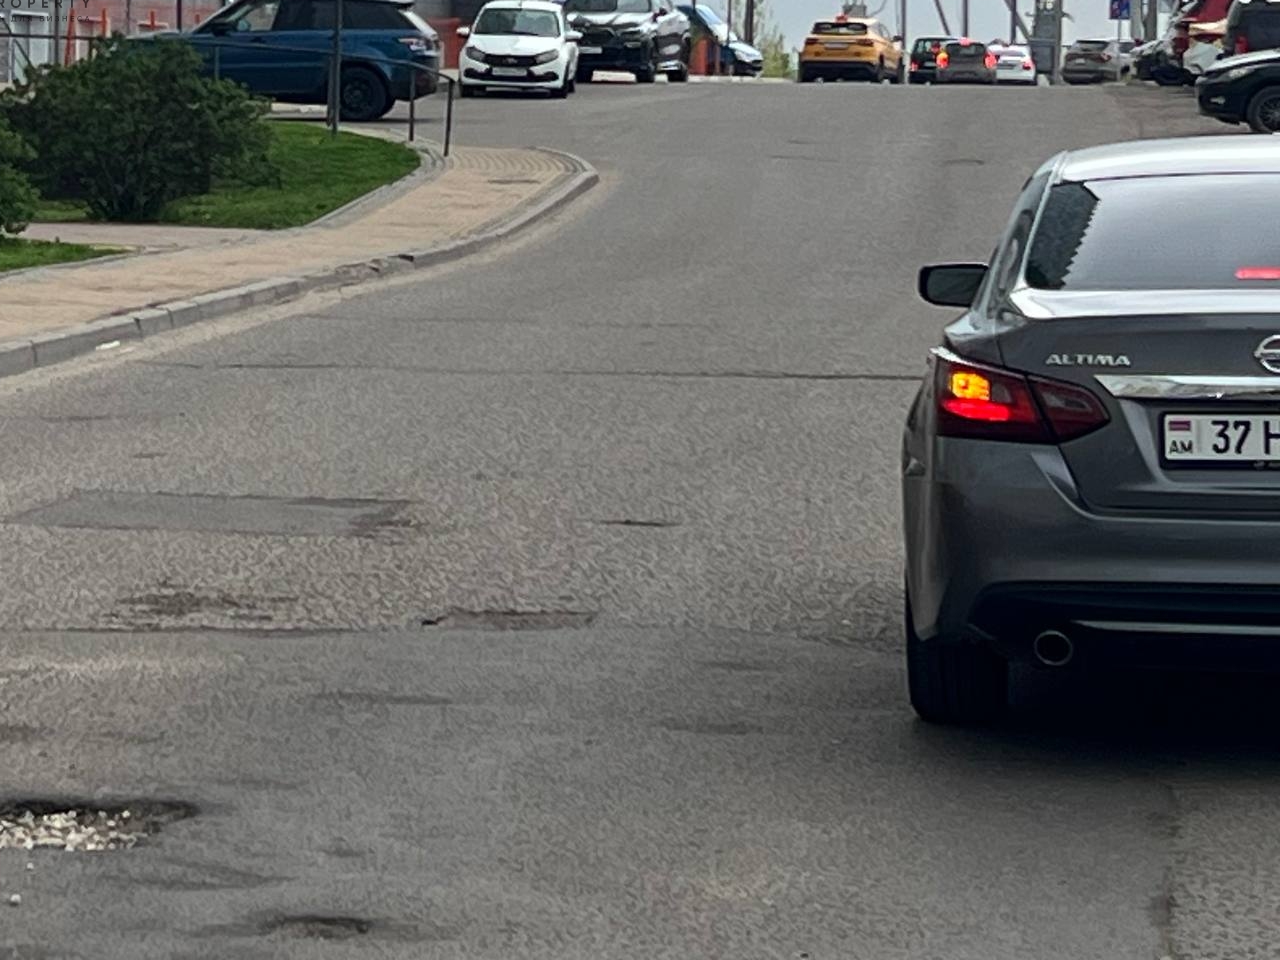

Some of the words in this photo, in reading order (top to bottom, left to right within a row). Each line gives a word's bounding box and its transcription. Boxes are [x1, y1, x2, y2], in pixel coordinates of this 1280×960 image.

[1045, 353, 1131, 366] ALTIMA
[1211, 420, 1251, 455] 37
[1169, 439, 1194, 454] AM
